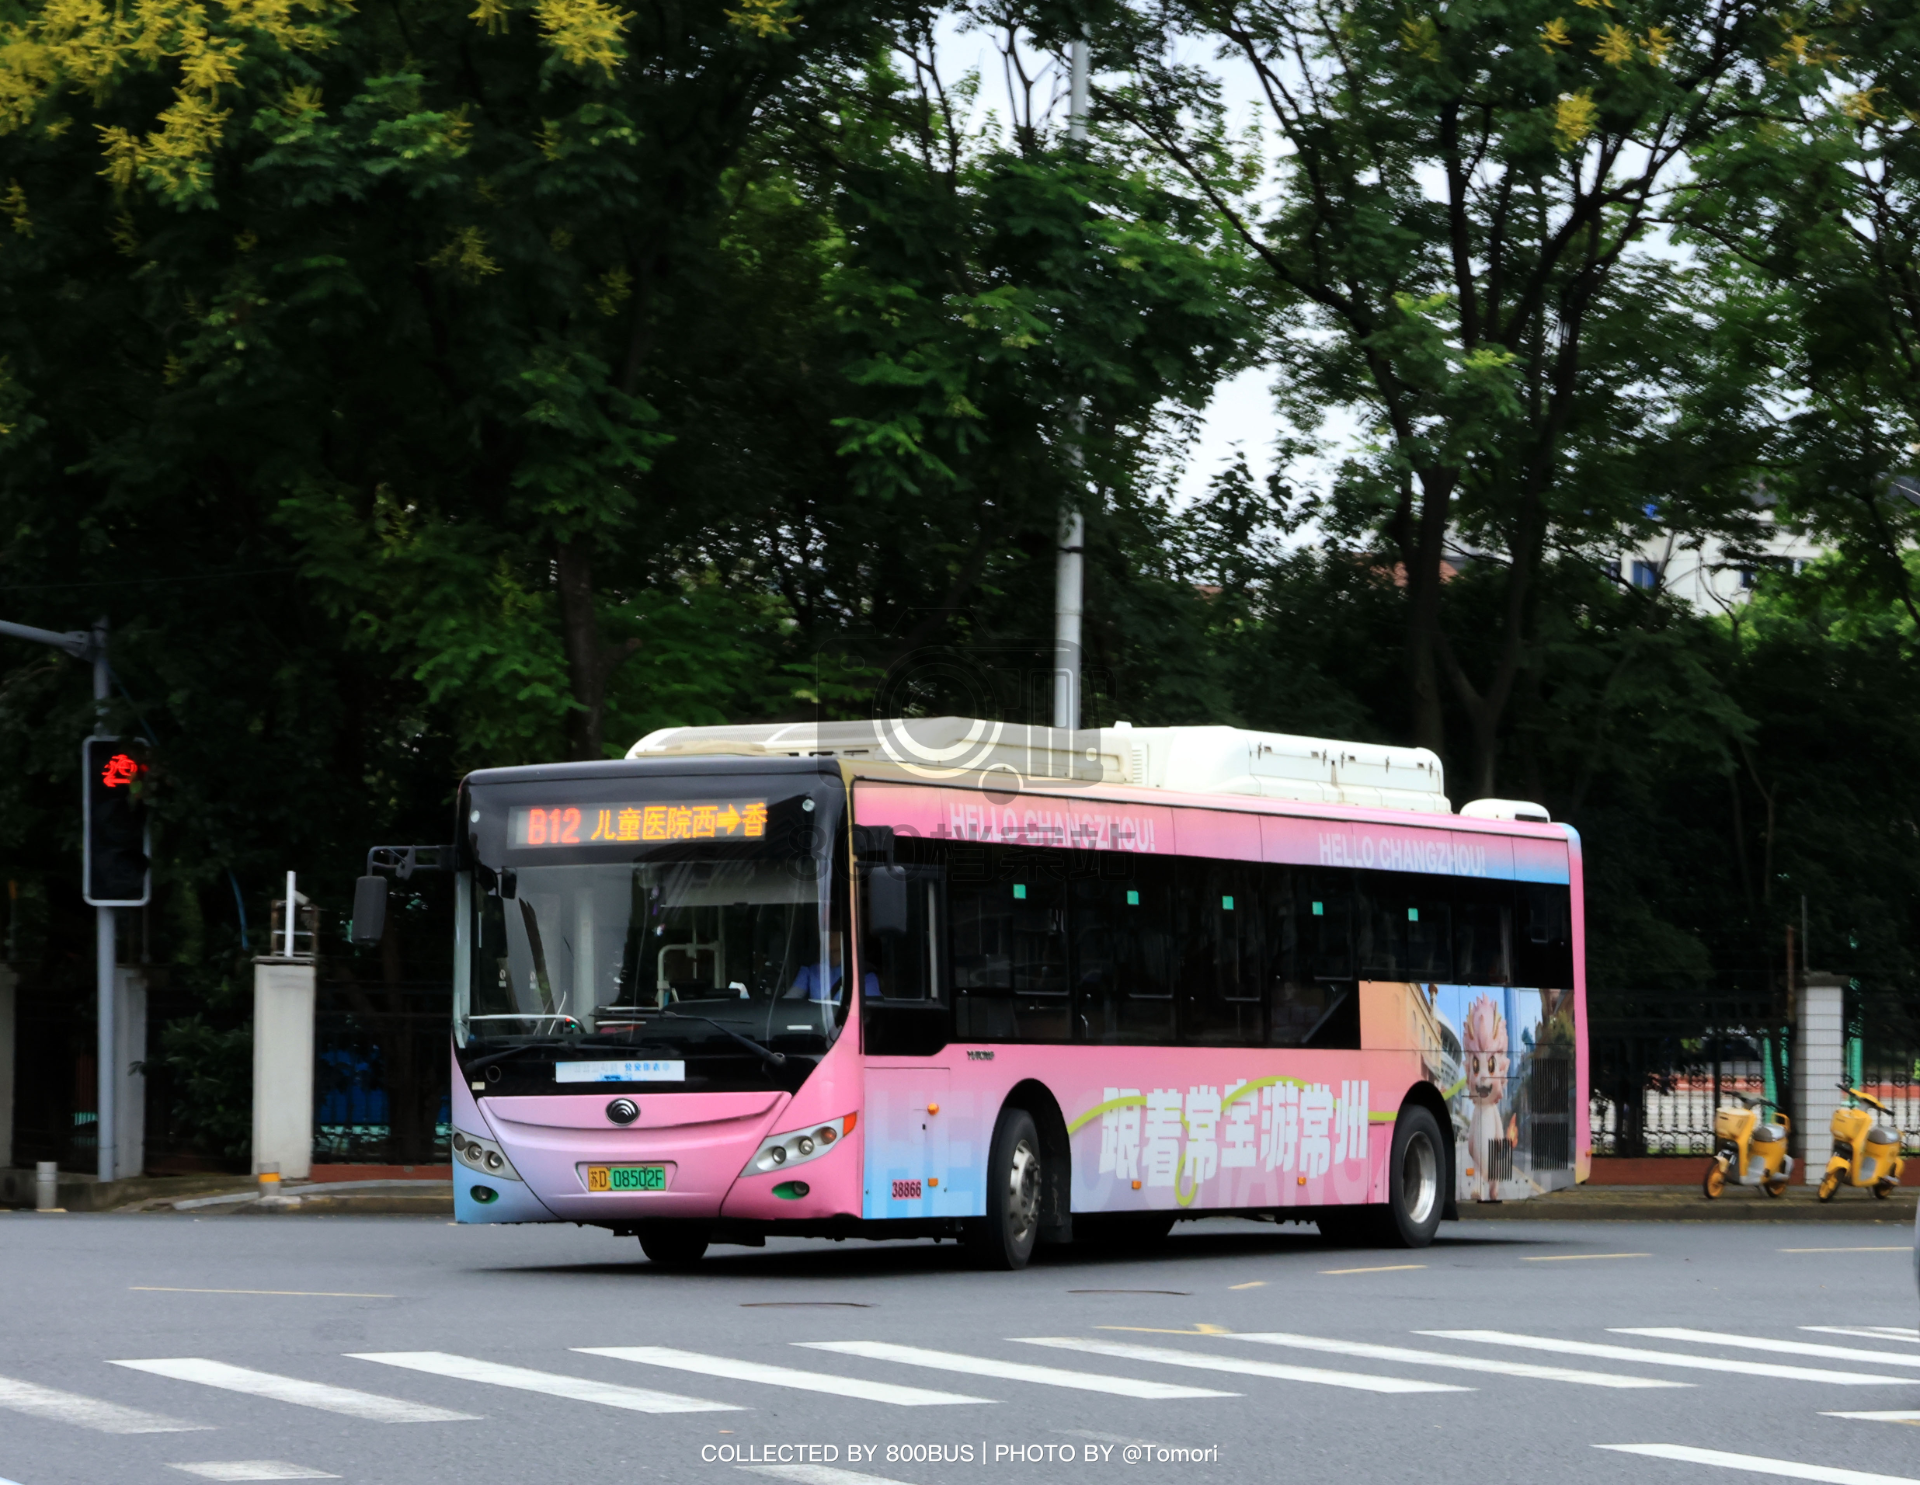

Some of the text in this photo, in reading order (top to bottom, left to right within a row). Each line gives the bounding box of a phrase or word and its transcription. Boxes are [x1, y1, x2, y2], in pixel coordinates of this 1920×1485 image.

[527, 808, 581, 846] B12
[590, 804, 717, 842] 儿童医院西
[949, 803, 1156, 853] HELLO CHANGZHOU!
[1319, 833, 1487, 877] HELLO CHANGZHOU!
[891, 1181, 922, 1198] 38866
